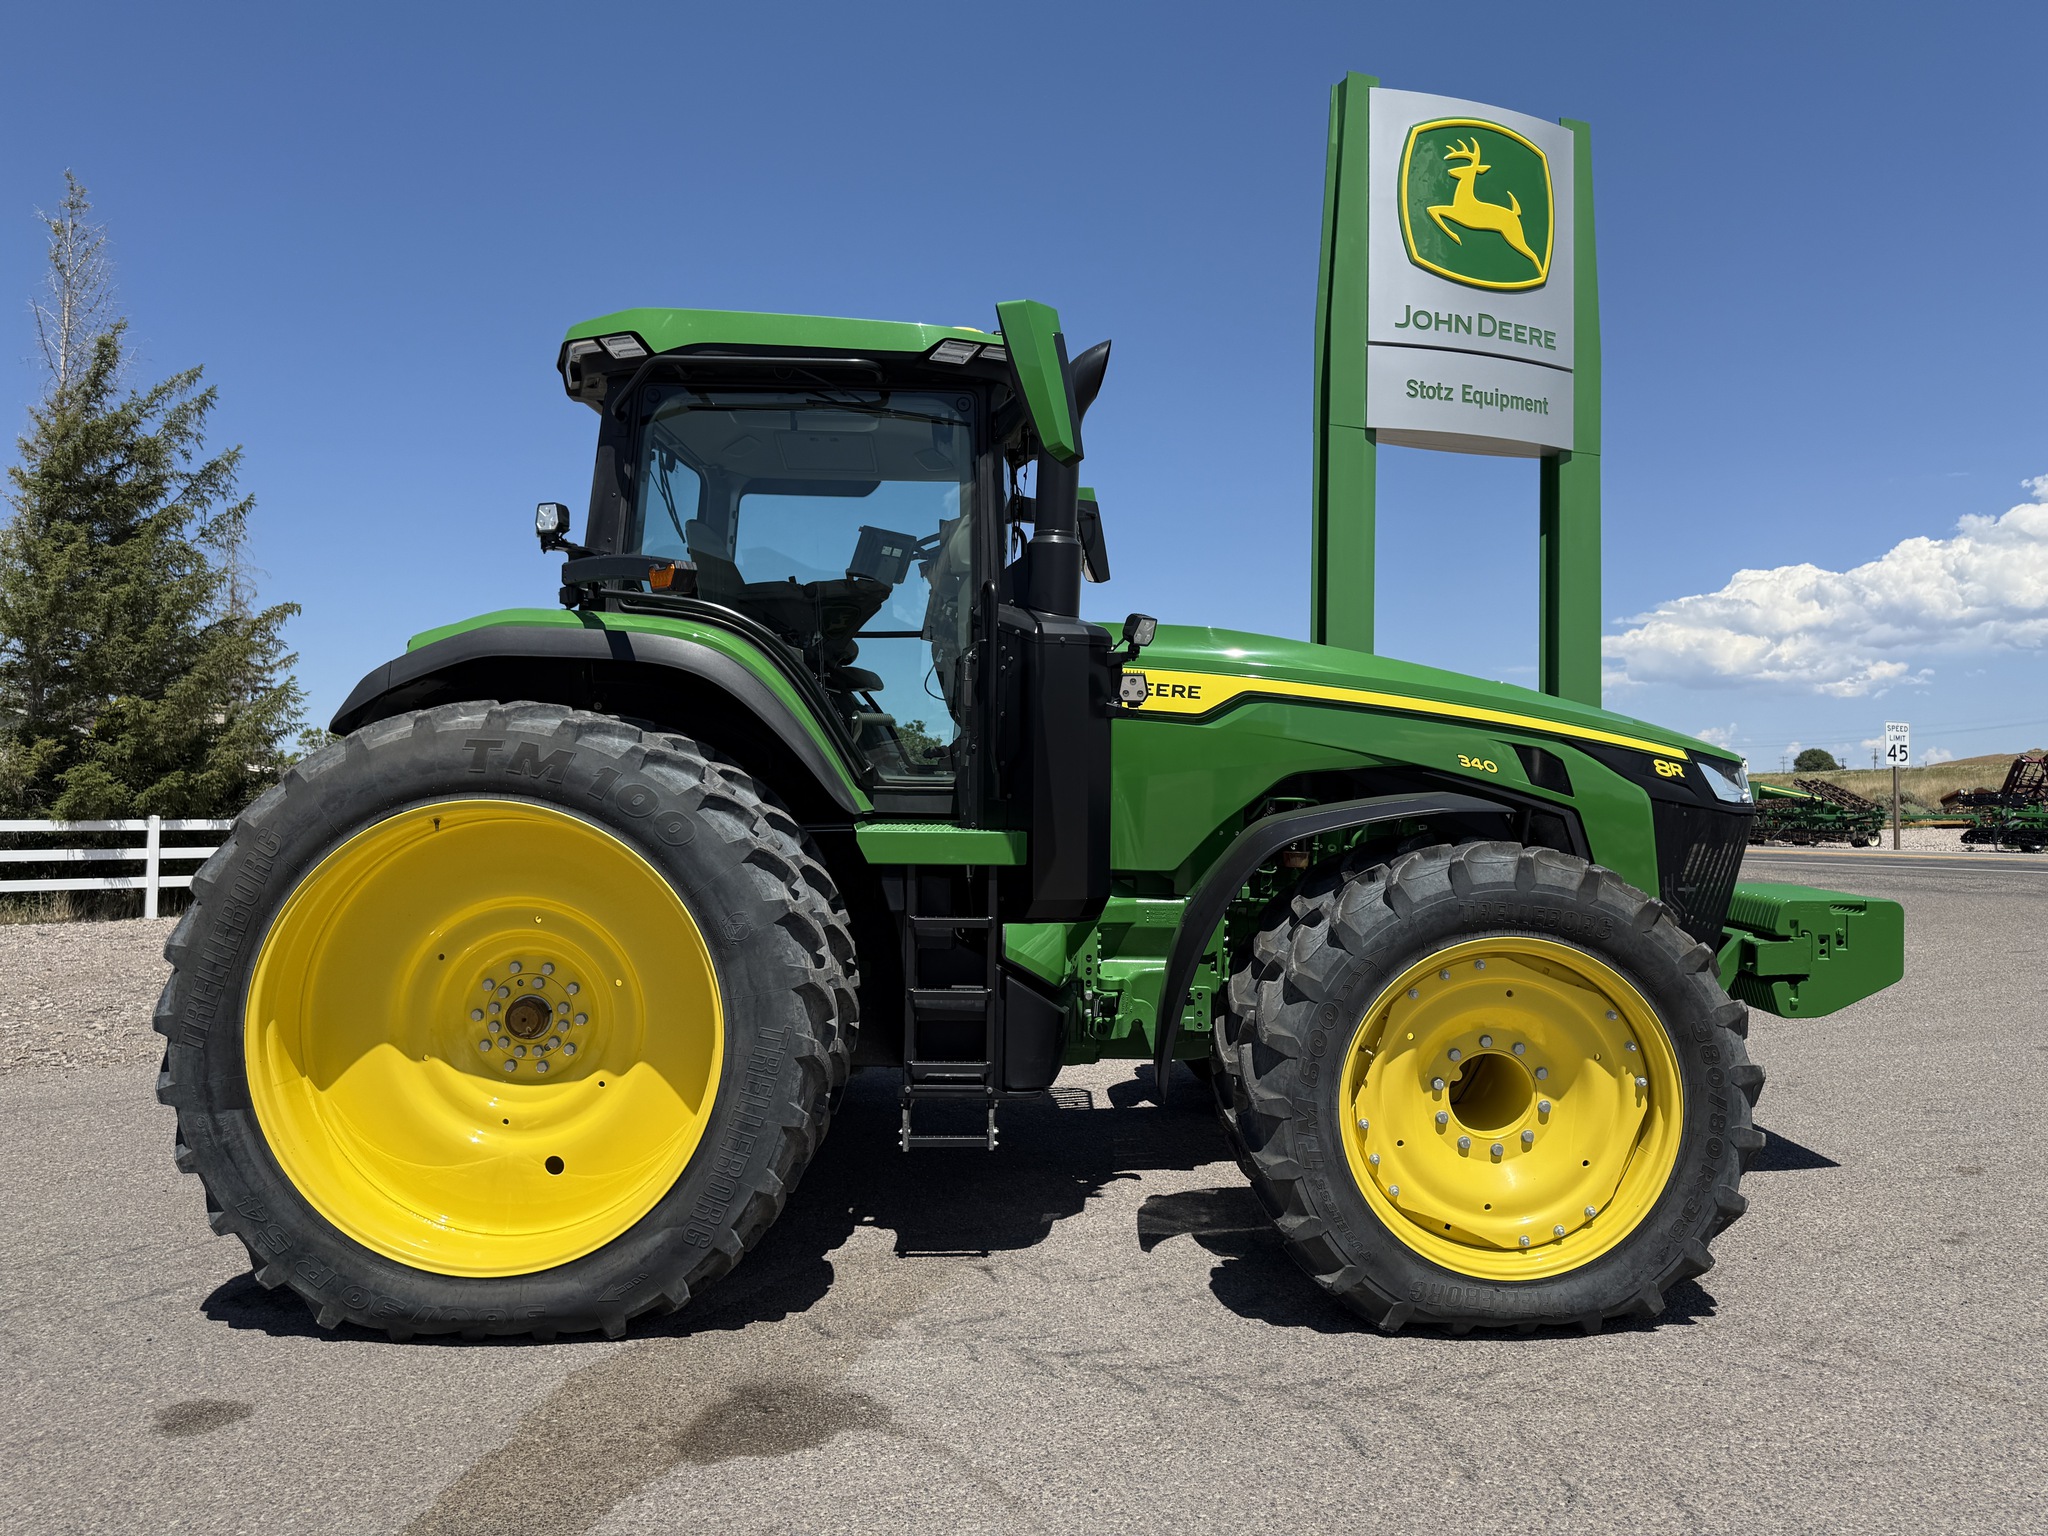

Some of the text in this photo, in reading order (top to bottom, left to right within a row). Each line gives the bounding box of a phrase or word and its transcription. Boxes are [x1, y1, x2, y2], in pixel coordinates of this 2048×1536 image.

[1395, 305, 1557, 351] JOHN DEERE
[1406, 379, 1549, 415] Stotz Equipment
[1146, 683, 1201, 699] EERE
[1457, 754, 1498, 773] 340
[1653, 759, 1685, 778] 8R
[1887, 744, 1908, 762] 45
[462, 738, 697, 846] TM 100
[175, 826, 282, 1049] TRELLEBORG
[1459, 900, 1614, 938] TRELLEBORG
[1296, 1001, 1340, 1169] TM 600
[1690, 1019, 1728, 1160] 380/80
[682, 1026, 793, 1249] TRELLEBORG
